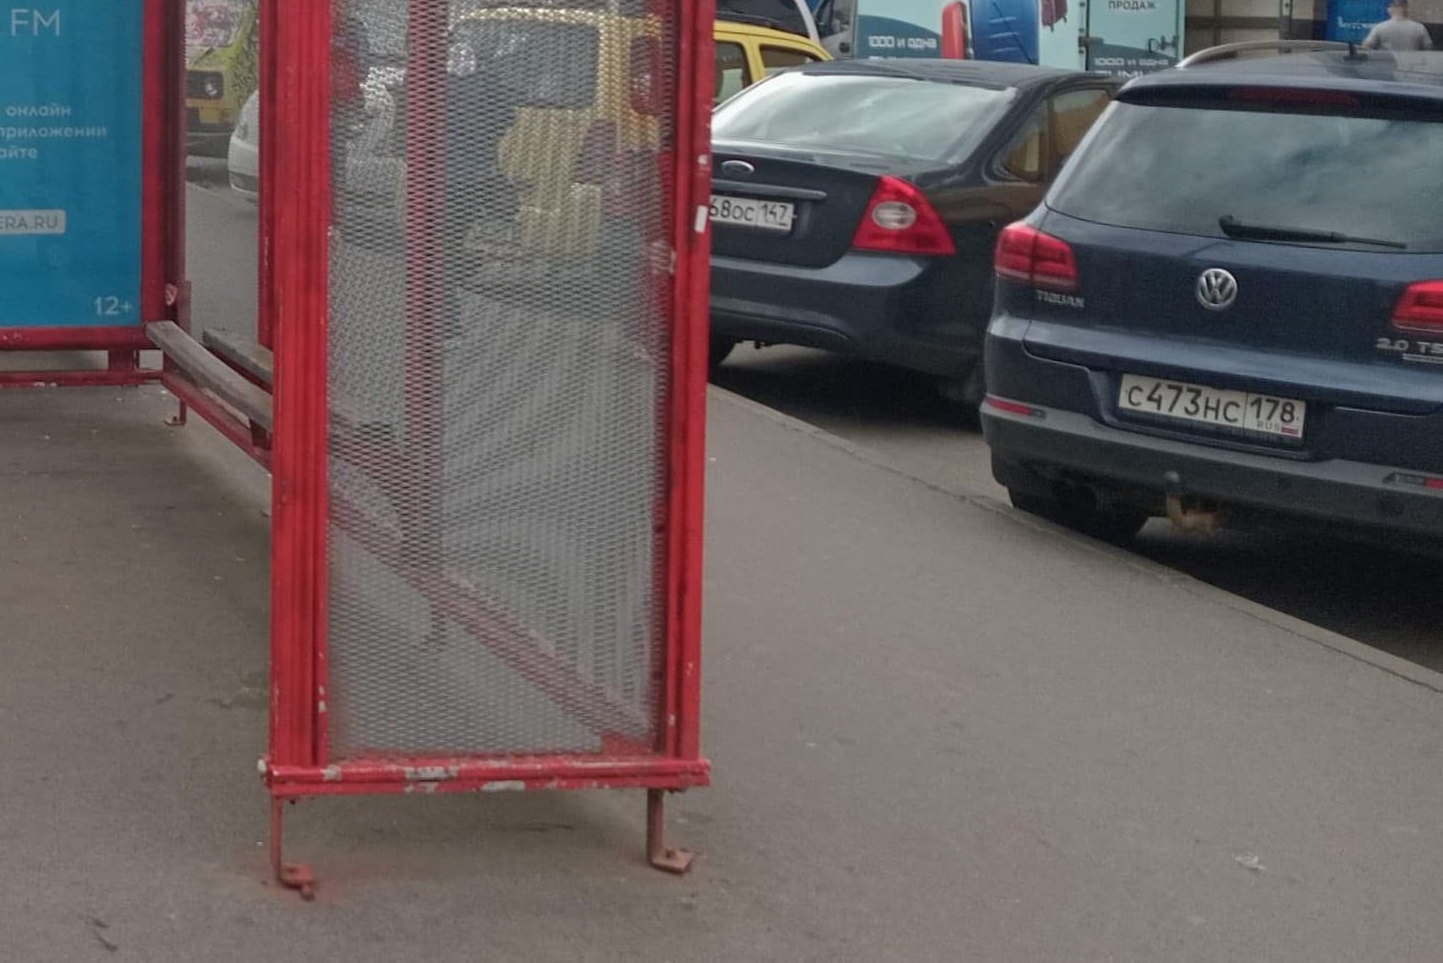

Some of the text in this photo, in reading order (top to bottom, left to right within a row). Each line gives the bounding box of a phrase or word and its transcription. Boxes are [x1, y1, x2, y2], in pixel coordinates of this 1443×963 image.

[1108, 0, 1156, 10] ПРОДАЖ
[11, 9, 61, 36] FM
[868, 35, 895, 47] 1000
[6, 103, 72, 117] онлайн
[761, 202, 788, 224] 147
[94, 295, 133, 315] 12+
[1127, 382, 1296, 423] С473НС 178
